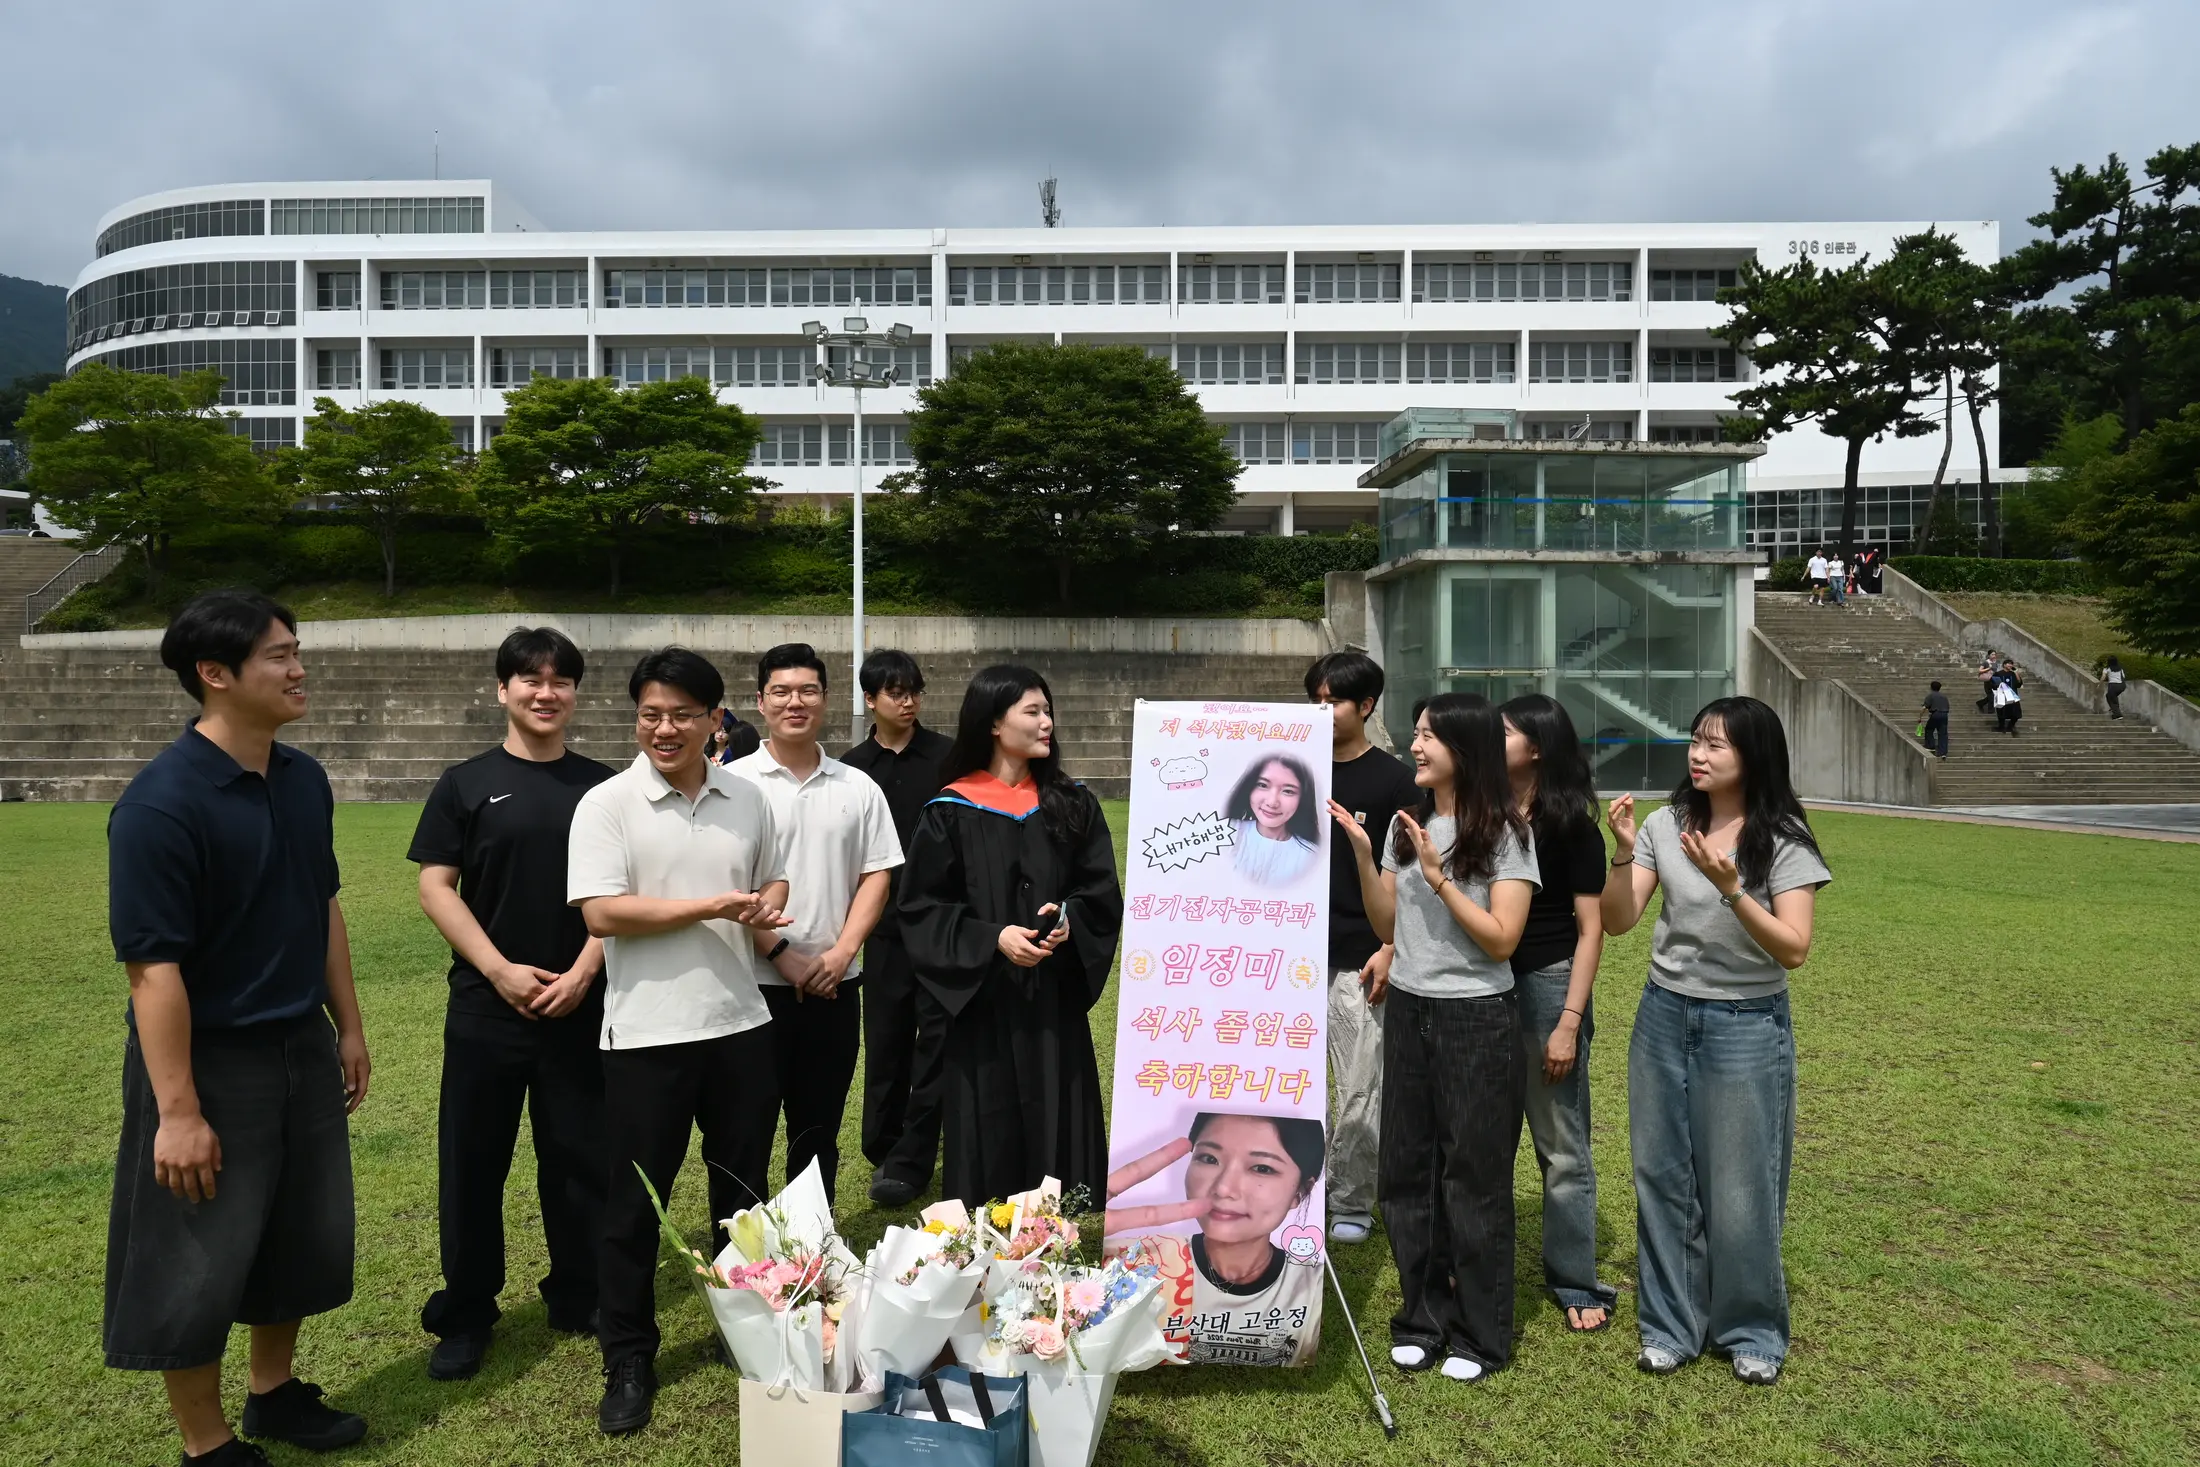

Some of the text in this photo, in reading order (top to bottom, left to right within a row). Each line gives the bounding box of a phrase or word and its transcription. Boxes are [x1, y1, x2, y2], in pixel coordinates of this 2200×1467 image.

[1788, 240, 1856, 254] 306 인문관
[1159, 718, 1312, 741] 저 석사됐어요!!!
[1152, 824, 1225, 859] 내가해냄
[1129, 894, 1316, 930] 전기전자공학과
[1133, 955, 1147, 975] 경
[1162, 944, 1284, 991] 임정미
[1295, 963, 1312, 985] 축
[1131, 1006, 1318, 1049] 석사 졸업을
[1135, 1060, 1312, 1105] 축하합니다
[1162, 1305, 1308, 1339] 부산대 고윤정
